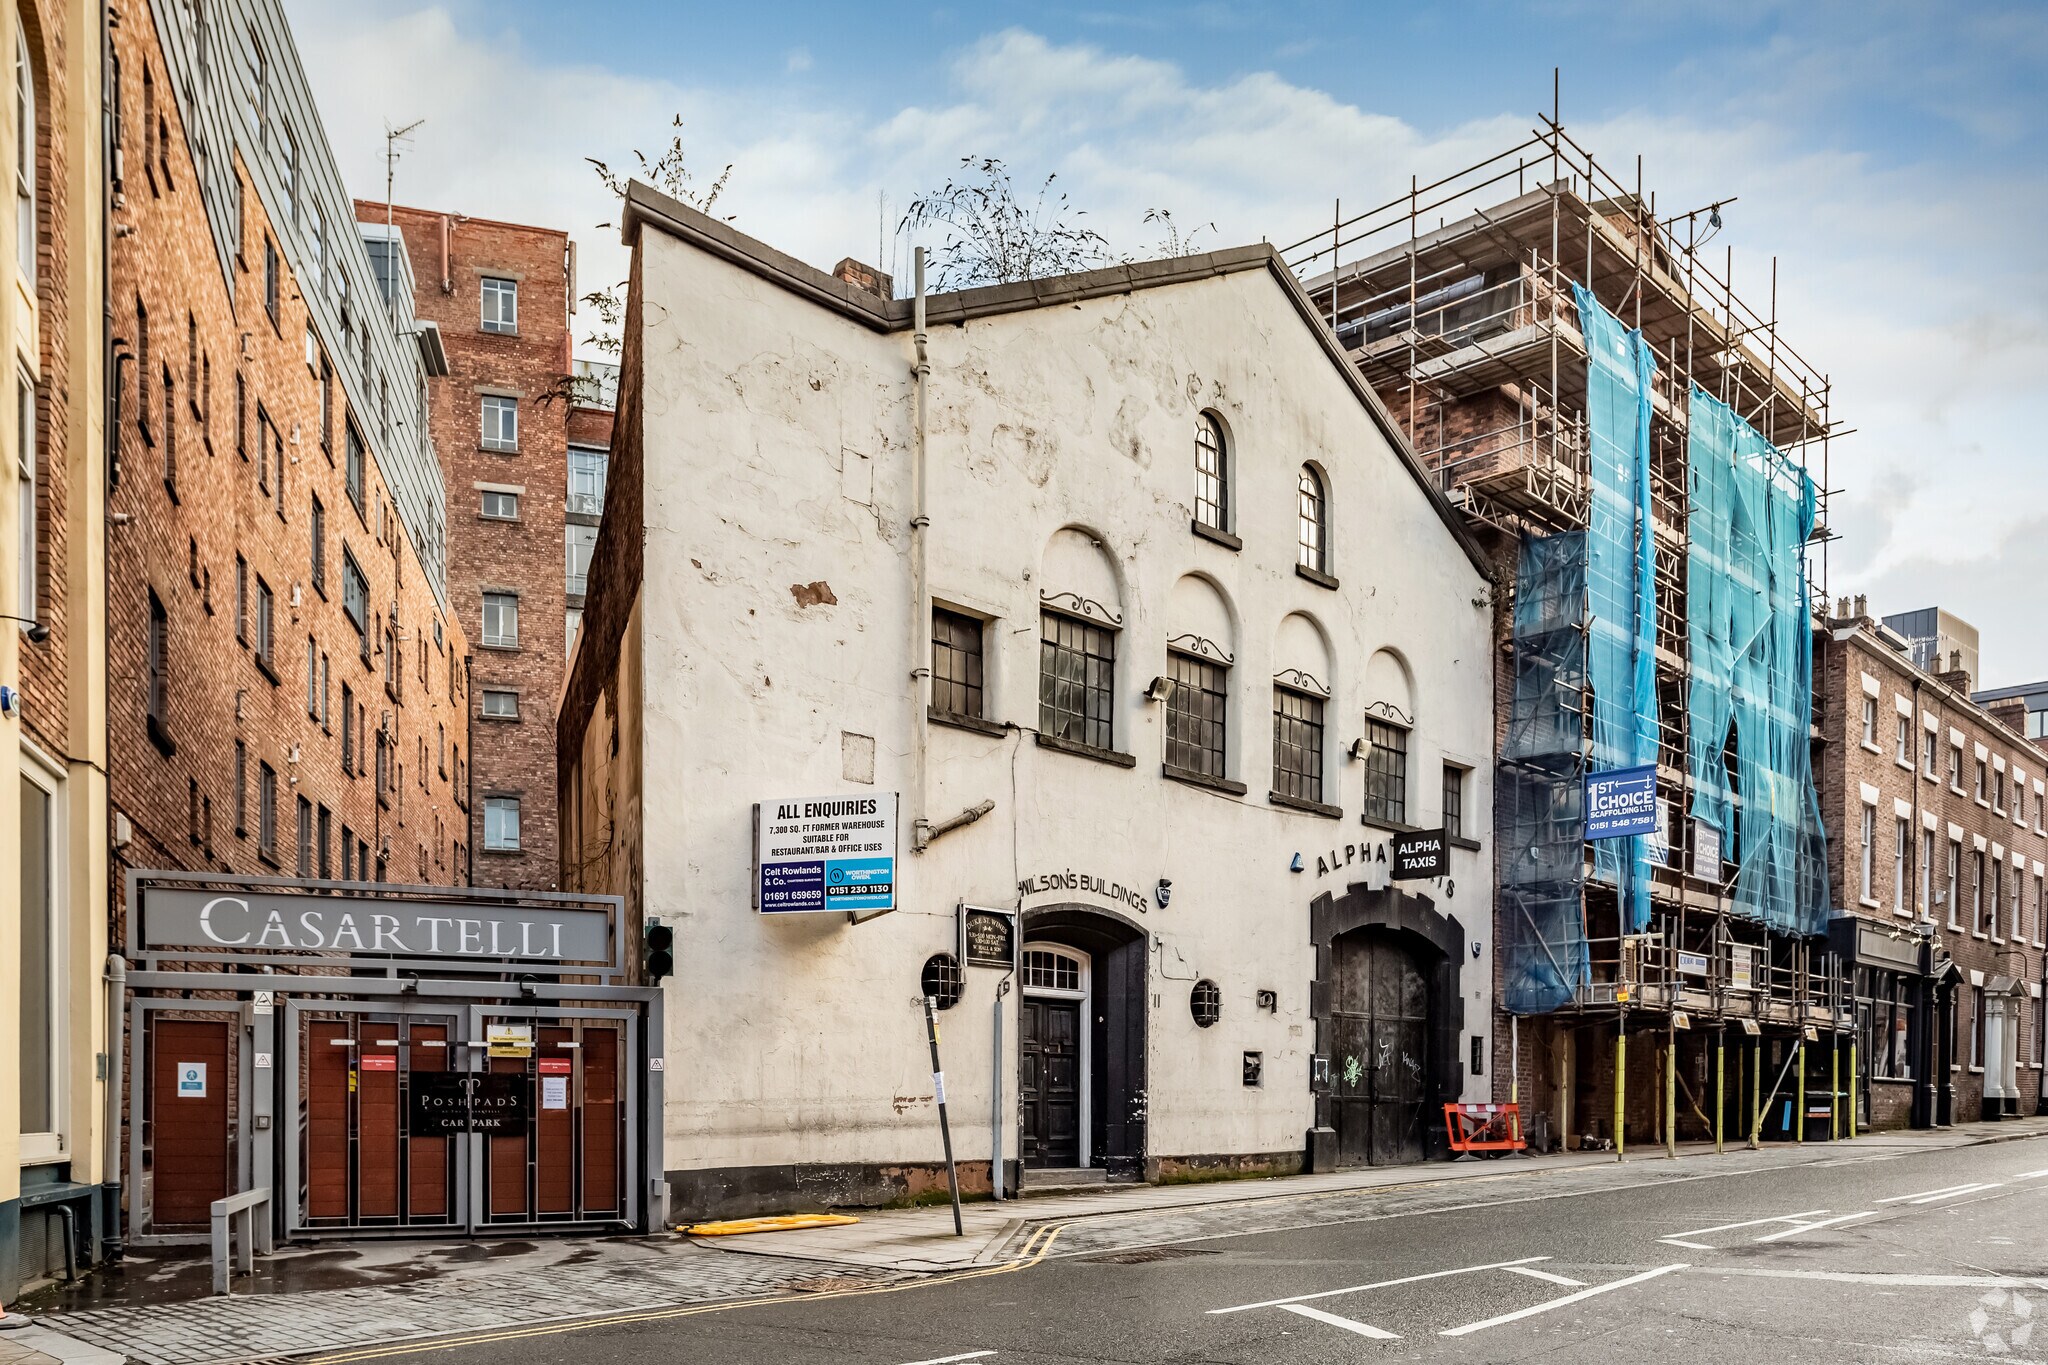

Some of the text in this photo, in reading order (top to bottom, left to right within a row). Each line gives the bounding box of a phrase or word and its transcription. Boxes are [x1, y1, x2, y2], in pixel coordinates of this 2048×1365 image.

[1598, 790, 1653, 810] CHOICE
[777, 799, 877, 820] ALL ENQUIRIES
[1590, 804, 1653, 819] SCAFFOLDING LTD
[769, 820, 885, 835] 7,300 SQ. FT FORMER WAREHOUSE
[1590, 816, 1654, 830] 0151 548 7581
[802, 833, 849, 844] SUITABLE FOR
[771, 843, 882, 857] RESTAURANT/BAR & OFFICE USES
[1398, 839, 1441, 855] ALPHA
[1318, 842, 1387, 878] ALPHA
[1403, 856, 1437, 870] TAXIS
[764, 865, 822, 876] Celt Rowlands
[764, 878, 771, 886] &
[772, 877, 786, 886] Co.
[764, 890, 822, 901] 01691 659659
[829, 884, 889, 895] 0151 230 1130
[1080, 874, 1147, 914] BUILDINGS
[764, 900, 822, 908] www.celtrowlands.co.uk
[199, 897, 564, 957] CASARTELLI
[441, 1119, 501, 1127] CAR PARK
